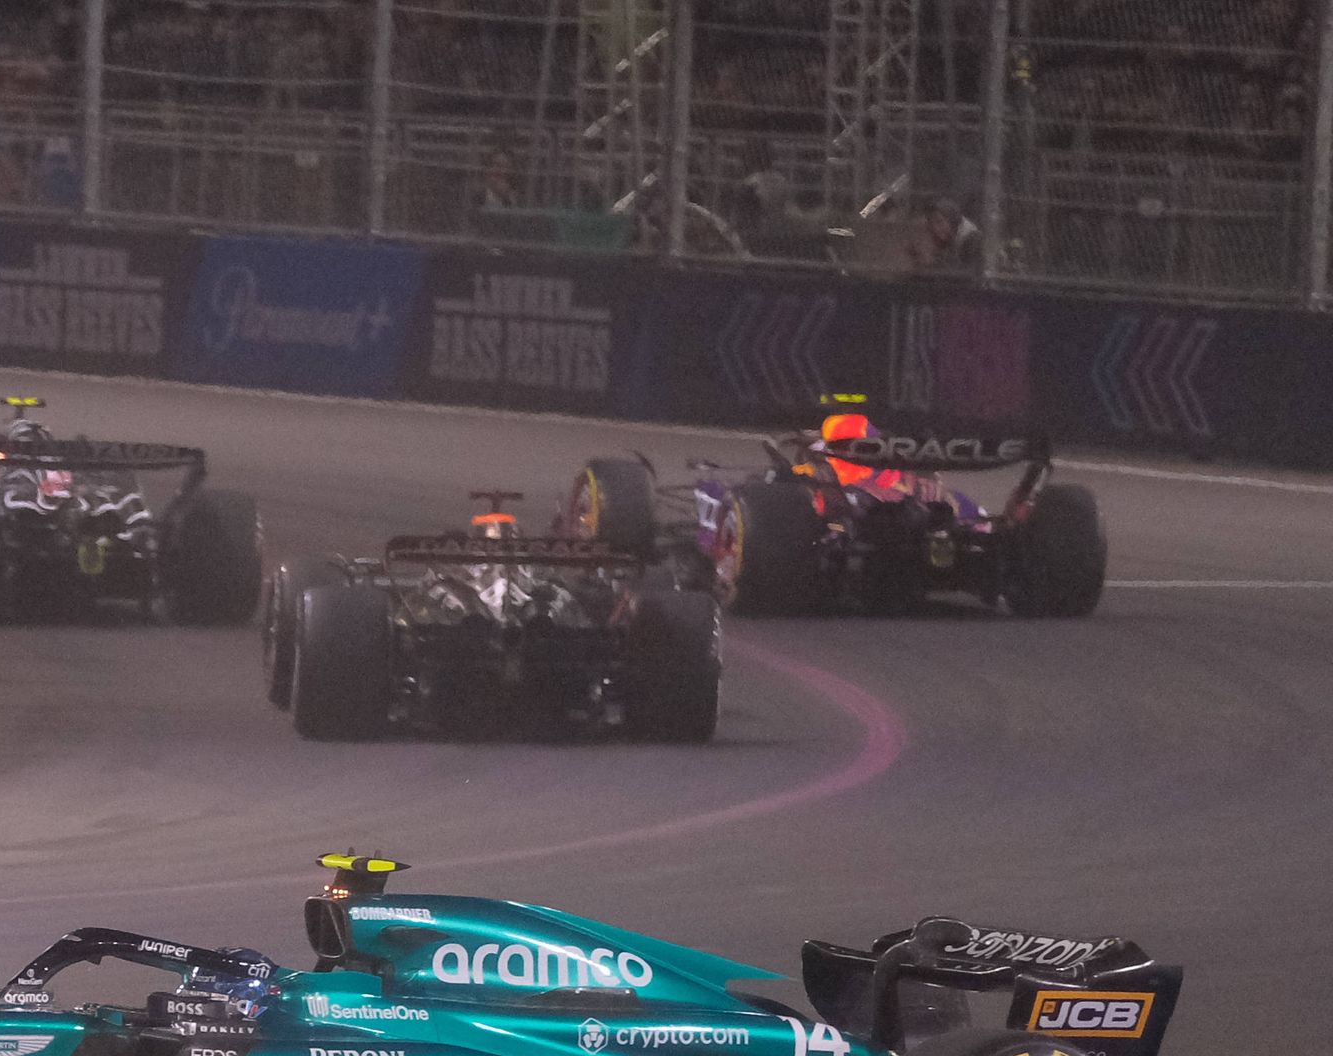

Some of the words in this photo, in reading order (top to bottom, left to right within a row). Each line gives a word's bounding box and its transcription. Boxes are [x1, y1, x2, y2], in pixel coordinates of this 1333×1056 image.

[850, 436, 1029, 461] ORACLE
[351, 907, 433, 923] BOMBARDIER
[432, 942, 654, 988] aramco
[4, 991, 50, 1004] aramco
[167, 1000, 205, 1017] BOSS
[330, 1003, 430, 1021] SentinelOne
[1039, 1000, 1141, 1030] JCB
[199, 1024, 255, 1035] OAKLEY
[615, 1020, 750, 1049] crypto.com
